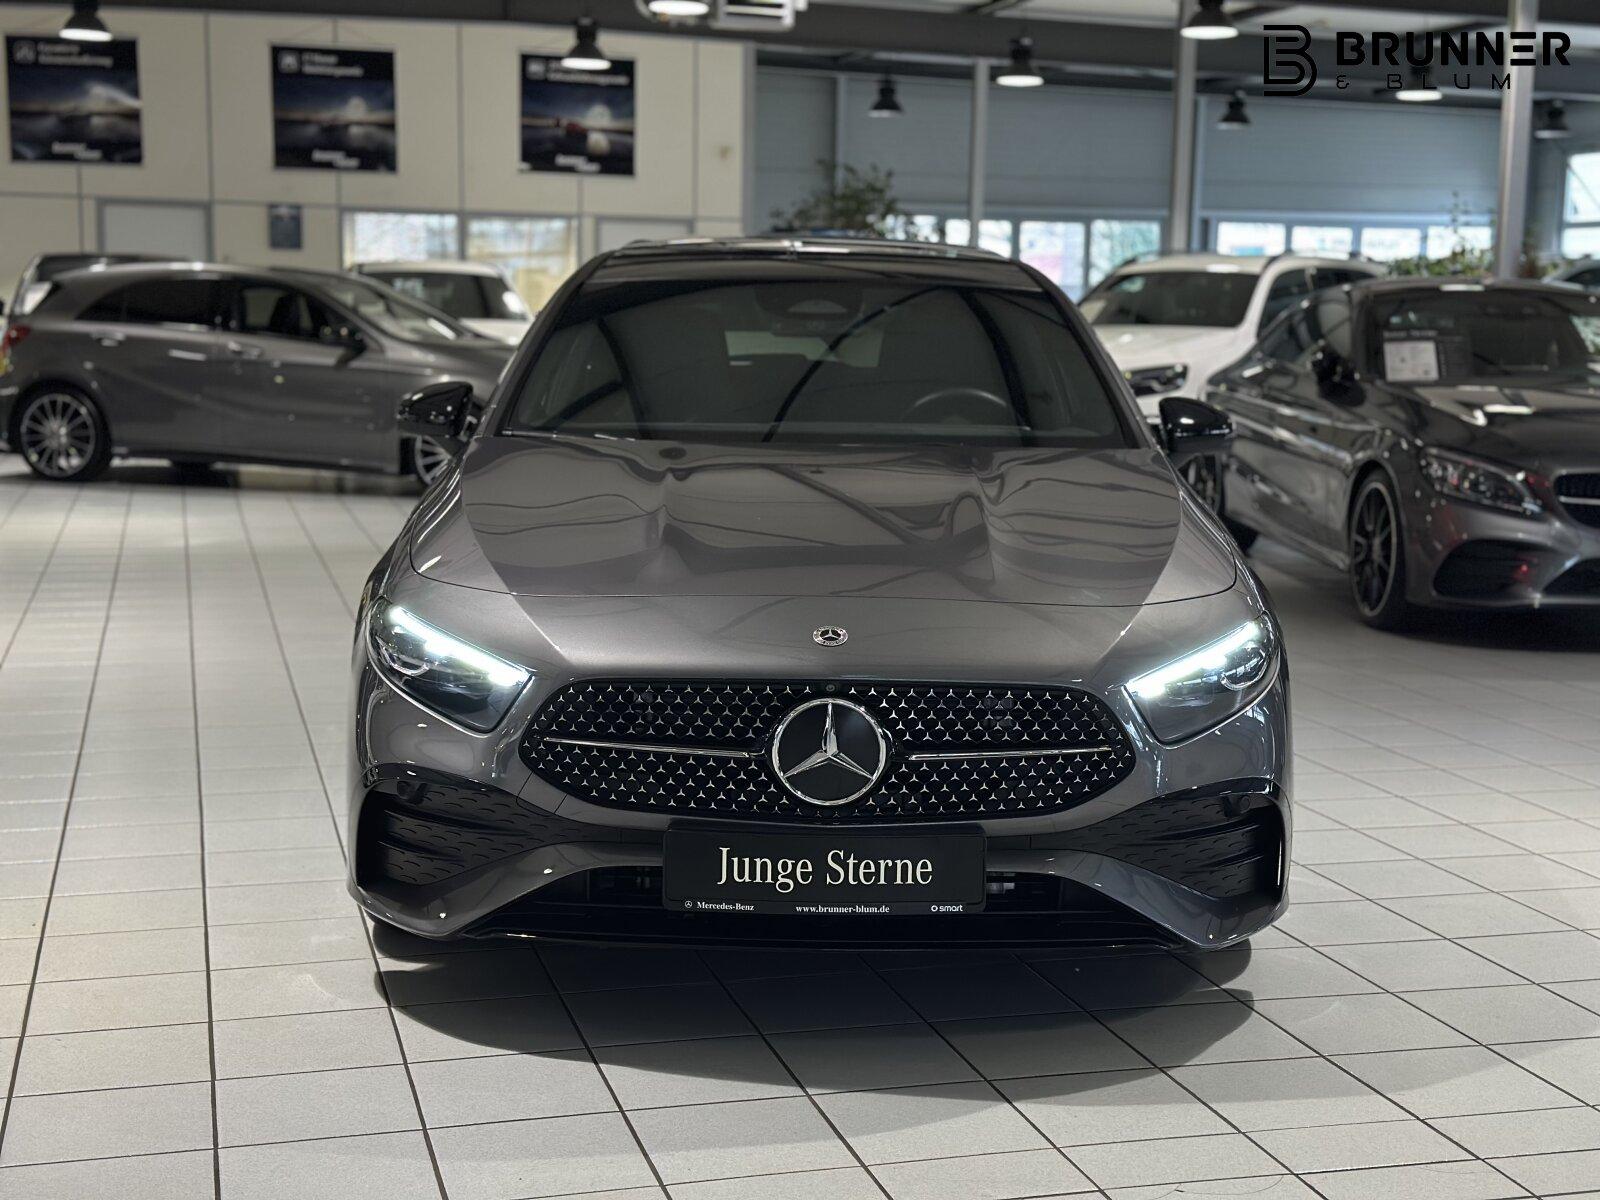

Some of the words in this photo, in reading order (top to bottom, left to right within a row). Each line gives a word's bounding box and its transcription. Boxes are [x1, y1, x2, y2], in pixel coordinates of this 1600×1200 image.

[716, 847, 813, 893] Junge
[826, 850, 933, 885] Sterne
[696, 901, 755, 911] Mercedes-Benz
[795, 904, 890, 914] www.brunner-blum.de
[938, 904, 964, 913] smart
